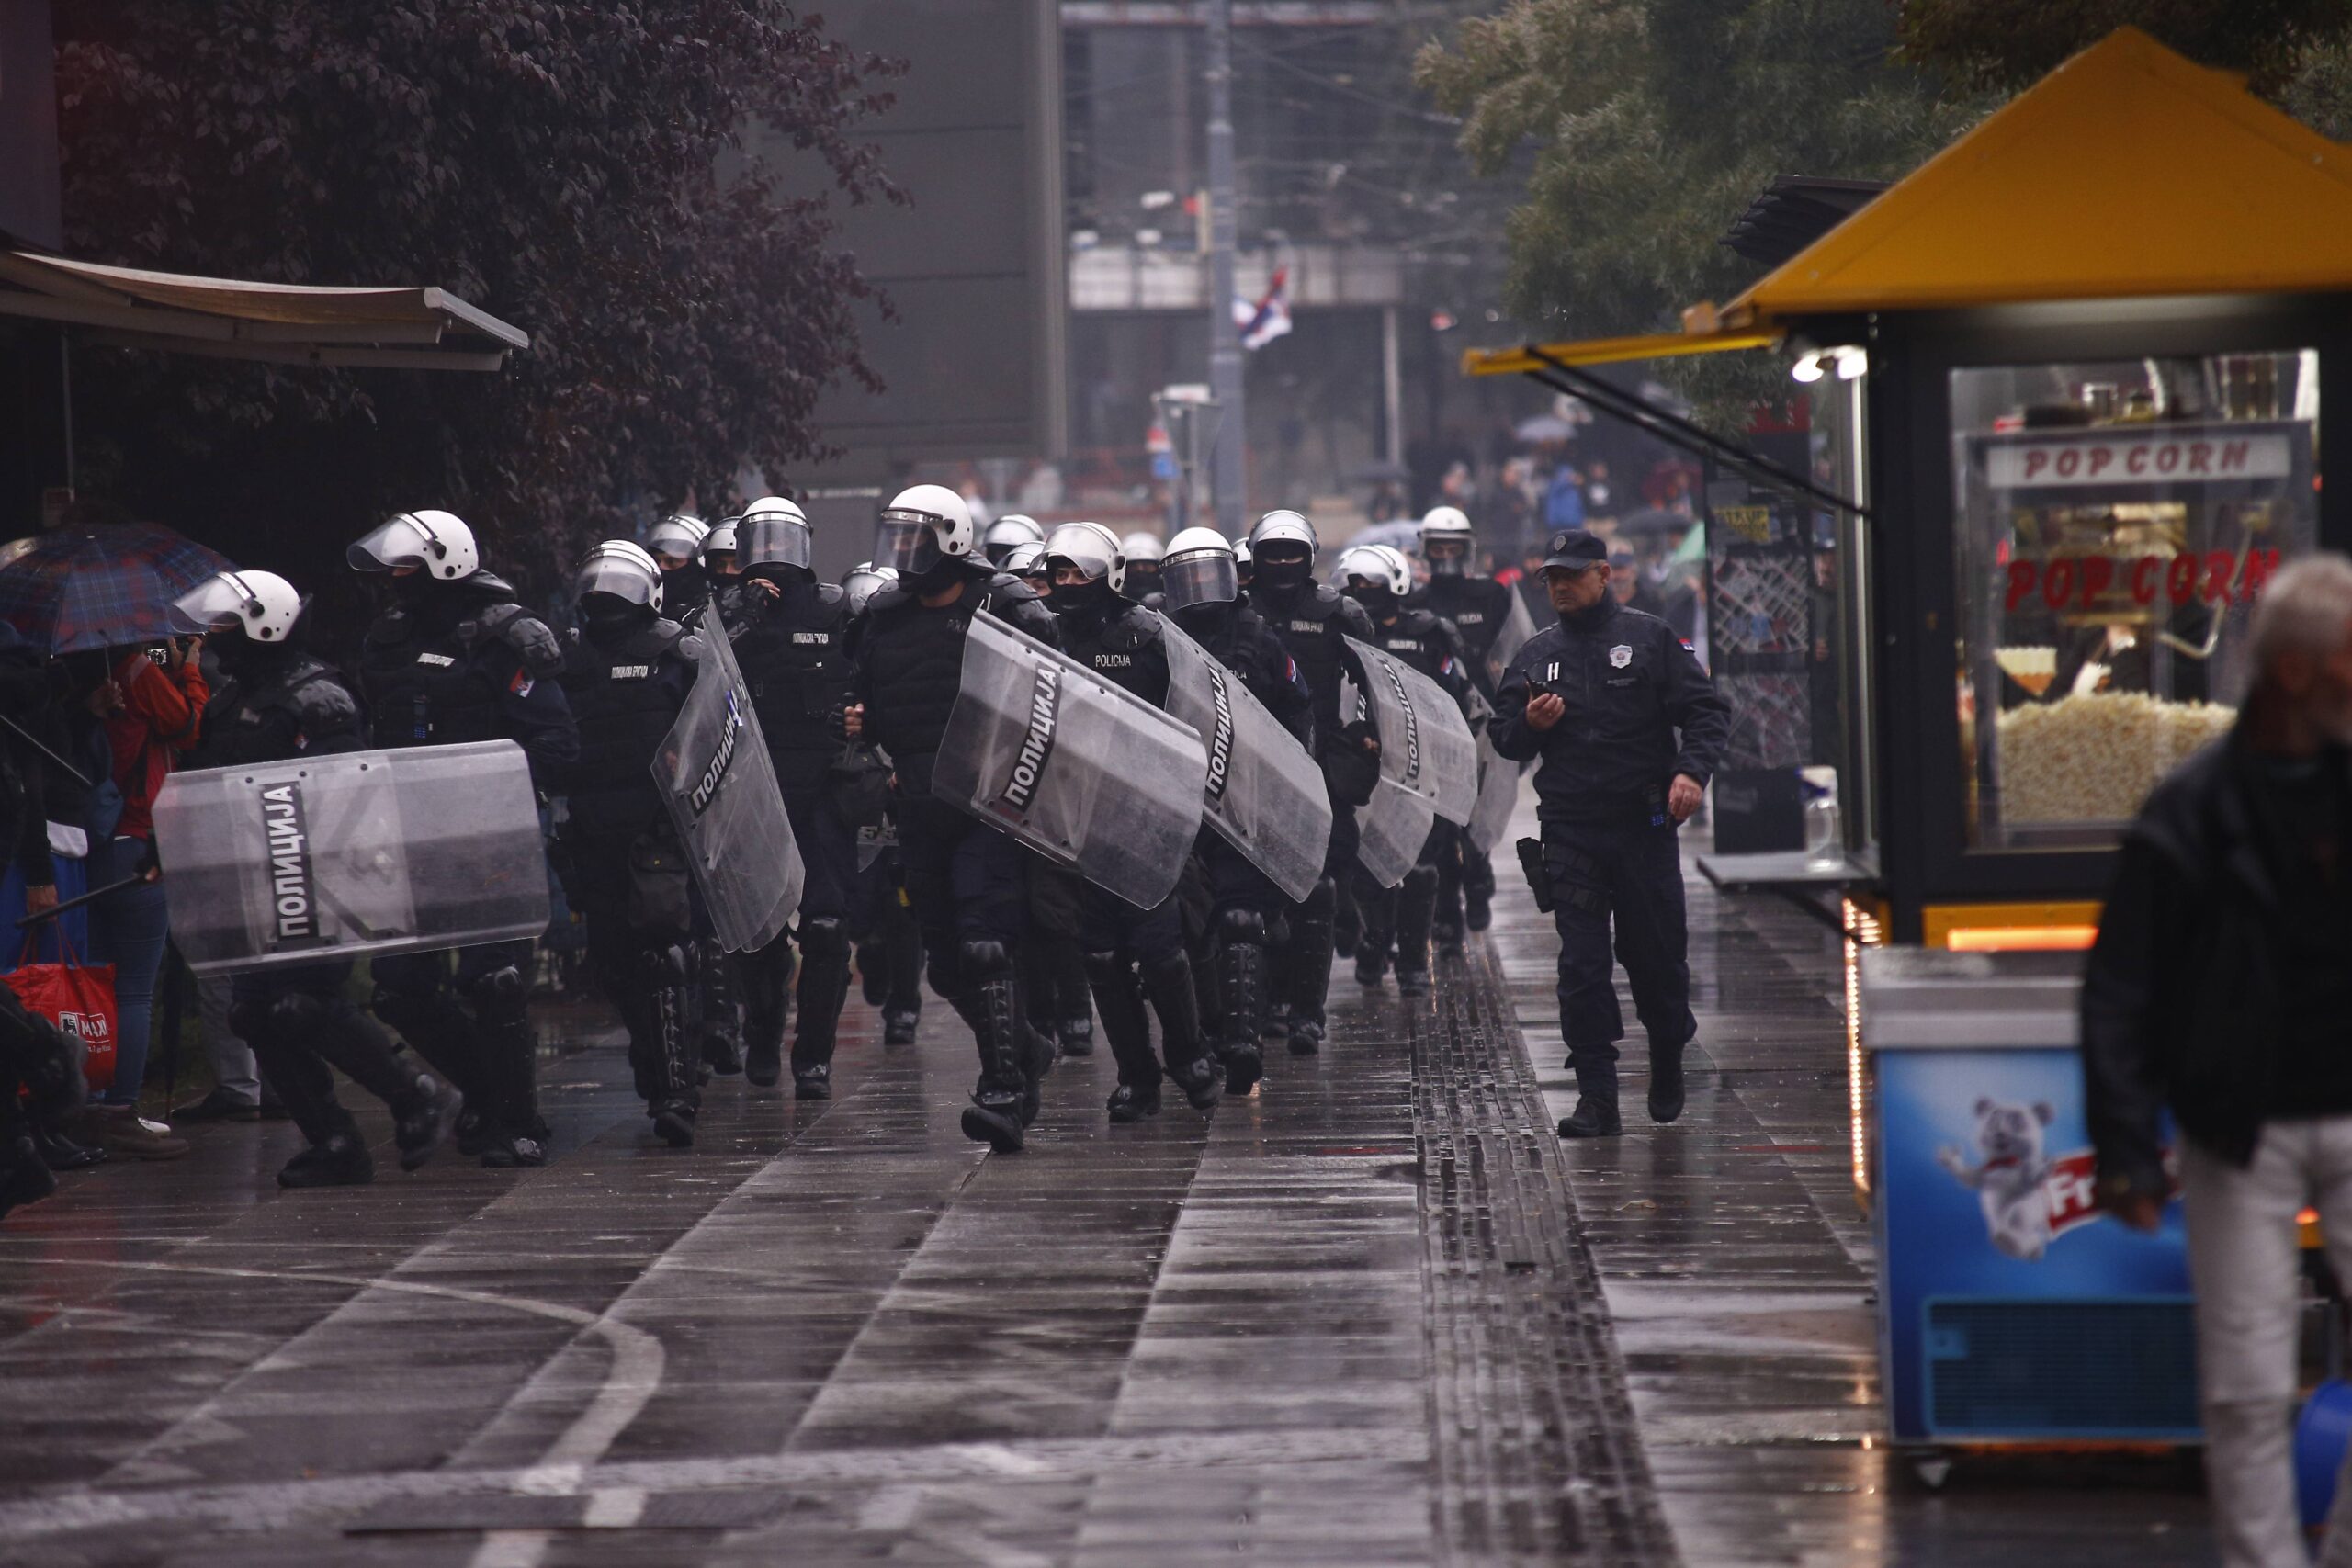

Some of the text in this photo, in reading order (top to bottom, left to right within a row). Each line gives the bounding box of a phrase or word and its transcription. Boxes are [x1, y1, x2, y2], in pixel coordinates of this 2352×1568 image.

[2025, 440, 2251, 479] POP CORN
[2006, 547, 2280, 613] POP CORN
[1095, 654, 1131, 667] POLICIJA
[1004, 668, 1057, 806] ПОЛИЦИЈА
[1205, 666, 1232, 795] ПОЛИЦИЈА
[263, 785, 310, 937] ПОЛИЦИЈА
